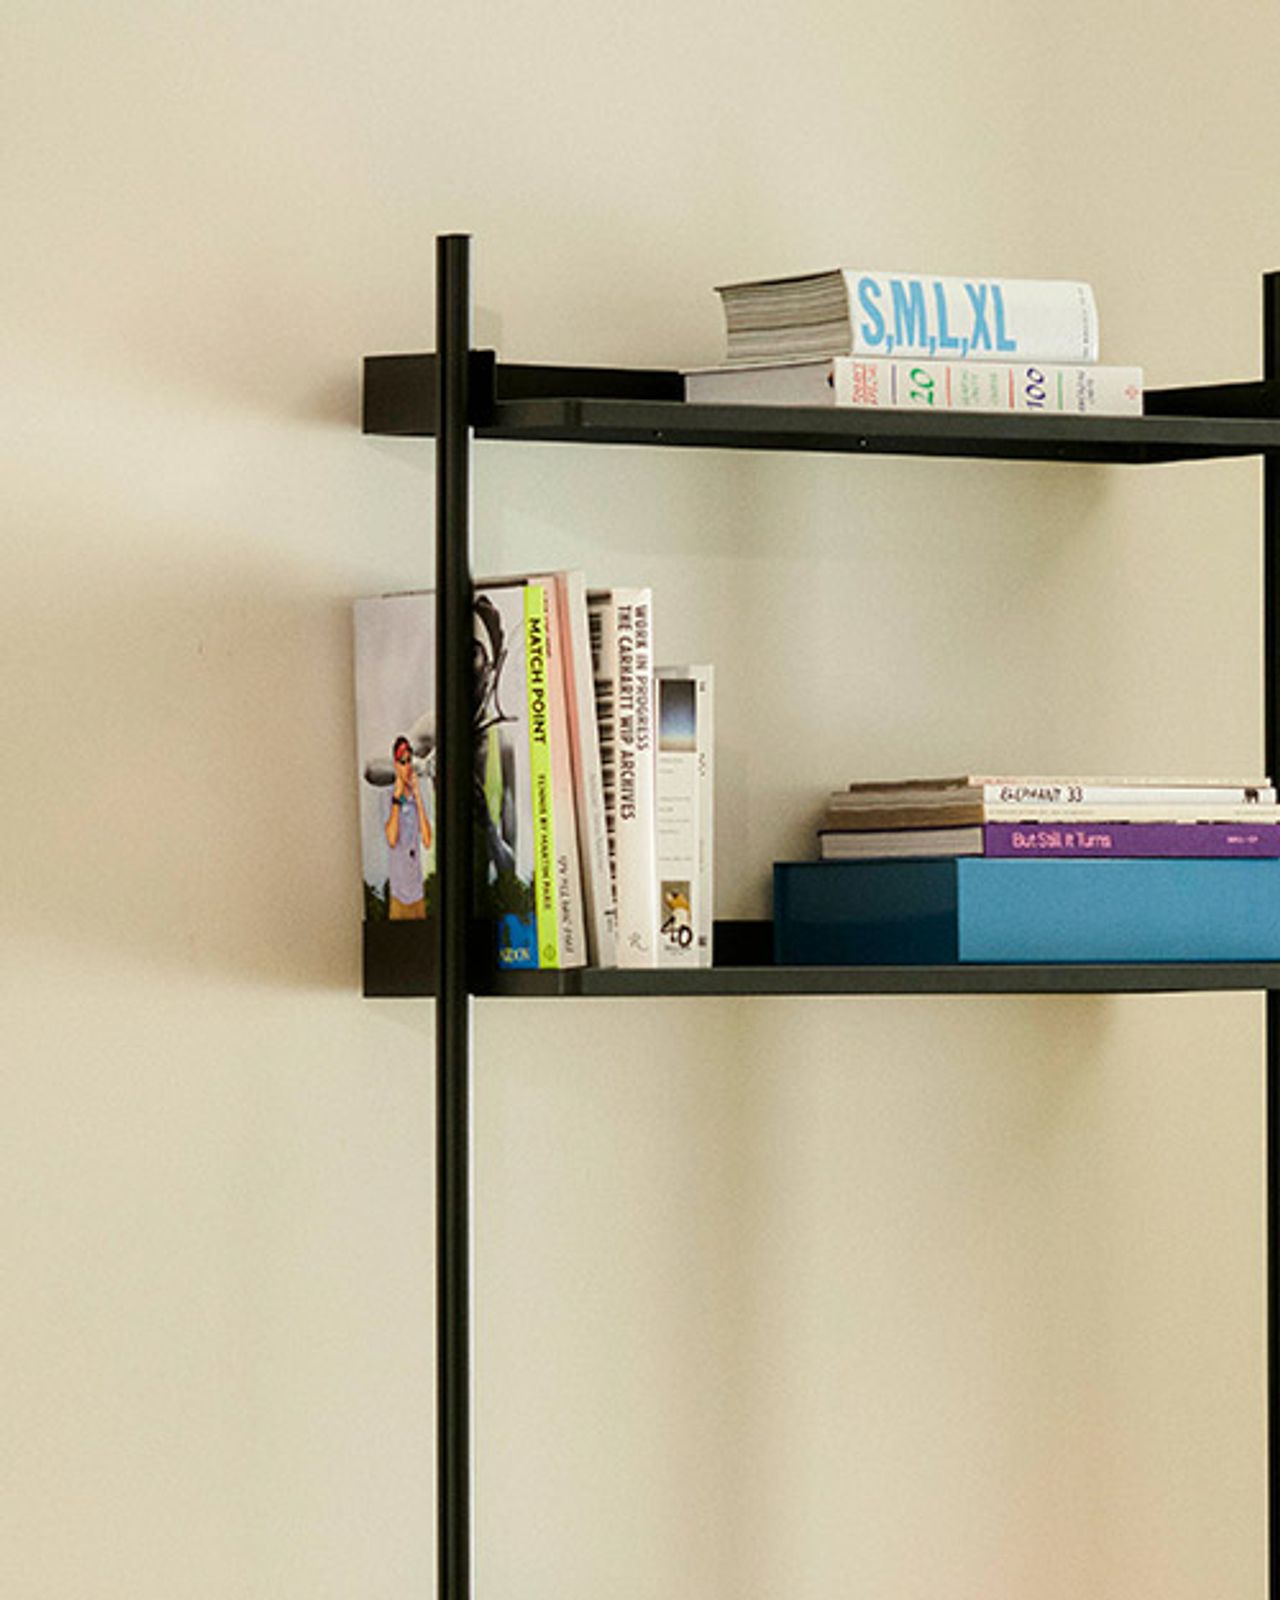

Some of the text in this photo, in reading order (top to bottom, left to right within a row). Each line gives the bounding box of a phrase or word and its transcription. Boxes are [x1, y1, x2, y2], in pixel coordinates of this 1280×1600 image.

[857, 277, 1017, 357] S,M,L,XL
[909, 367, 935, 406] 20
[1025, 367, 1046, 409] 100
[530, 617, 547, 744] MATCH POINT
[634, 604, 649, 751] WORK IN PROGRESS
[617, 605, 636, 821] THE CARHARTT WIP ARCHIVES
[1000, 786, 1084, 804] ELEPHANT 33
[1012, 832, 1035, 848] But
[1064, 832, 1075, 848] It
[1077, 832, 1112, 848] Turns
